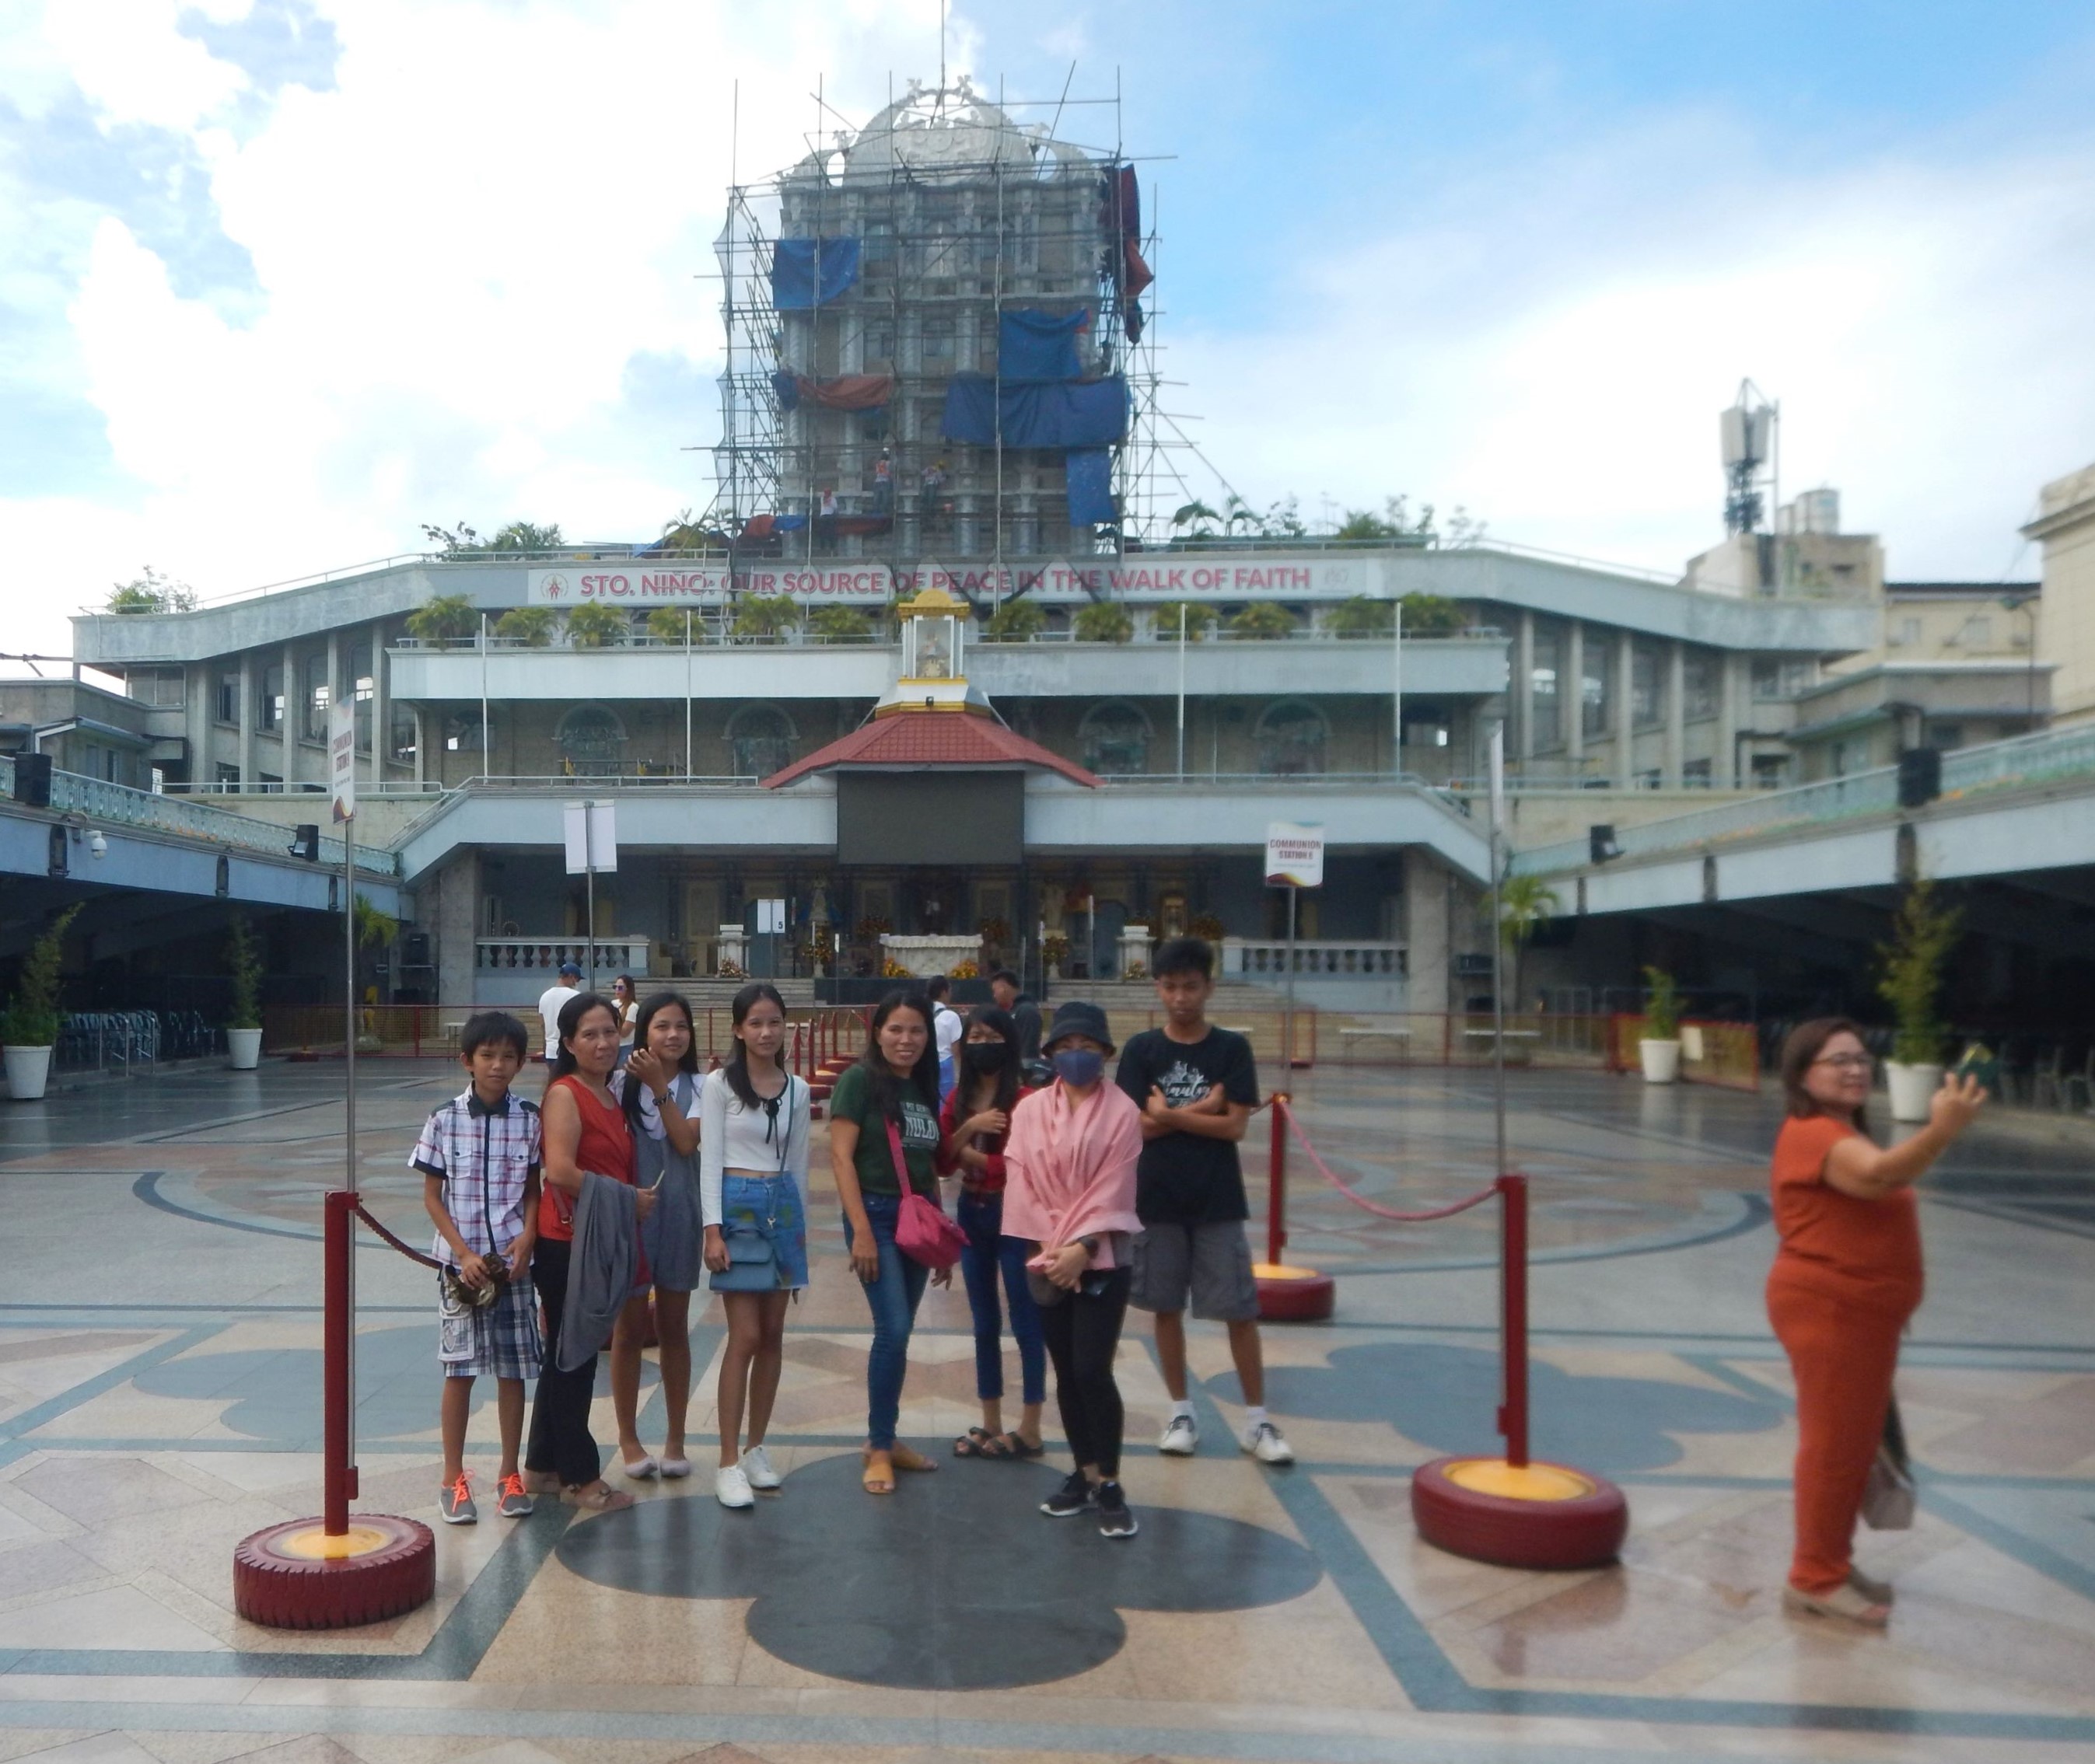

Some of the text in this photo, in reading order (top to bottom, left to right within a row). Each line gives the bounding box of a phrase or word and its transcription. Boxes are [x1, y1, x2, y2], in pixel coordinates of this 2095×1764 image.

[581, 575, 635, 596] STO.
[721, 572, 776, 594] OUR
[782, 571, 885, 595] SOURCE
[890, 572, 925, 594] OF
[932, 571, 1010, 593] PEACE
[1019, 570, 1045, 592] IN
[1051, 569, 1103, 592] THE
[1107, 568, 1187, 591] WALK
[1191, 568, 1228, 591] OF
[1234, 567, 1311, 590] FAITH
[1270, 839, 1321, 849] COMMUNION
[1278, 851, 1307, 860] STATION
[778, 920, 783, 930] 5
